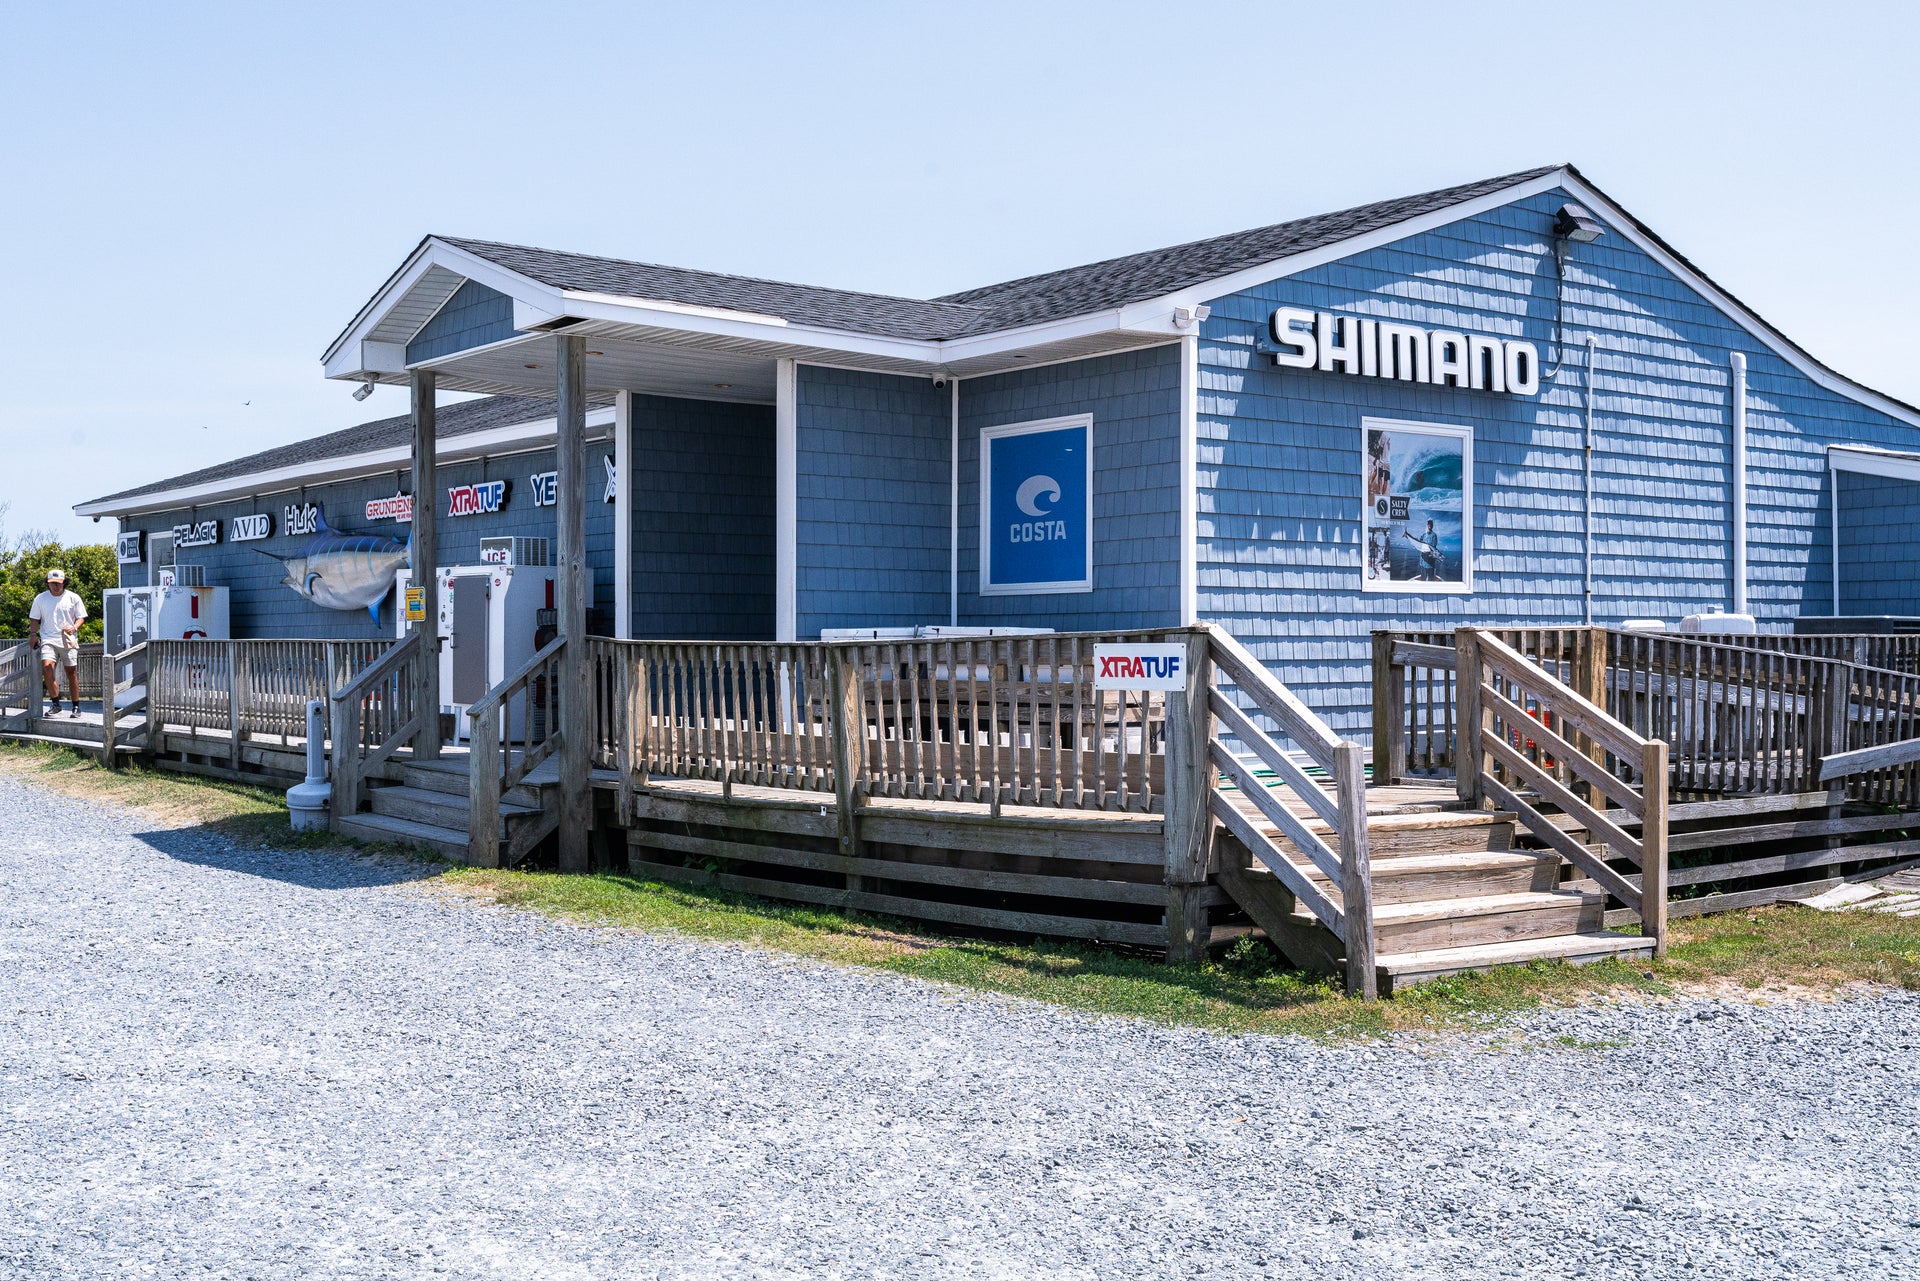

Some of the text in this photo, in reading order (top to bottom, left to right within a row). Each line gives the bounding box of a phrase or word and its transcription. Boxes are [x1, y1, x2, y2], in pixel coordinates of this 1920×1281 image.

[1275, 306, 1539, 396] SHIMANO
[450, 484, 502, 514] XTRATUF
[532, 475, 557, 502] YE
[1391, 500, 1407, 509] SALTY
[1391, 509, 1406, 517] CREW
[174, 523, 217, 545] PELAGIC
[231, 516, 269, 539] AVID
[1010, 520, 1067, 543] COSTA
[487, 551, 506, 562] ICE
[163, 576, 173, 586] ICE
[1099, 656, 1180, 679] XTRATUF
